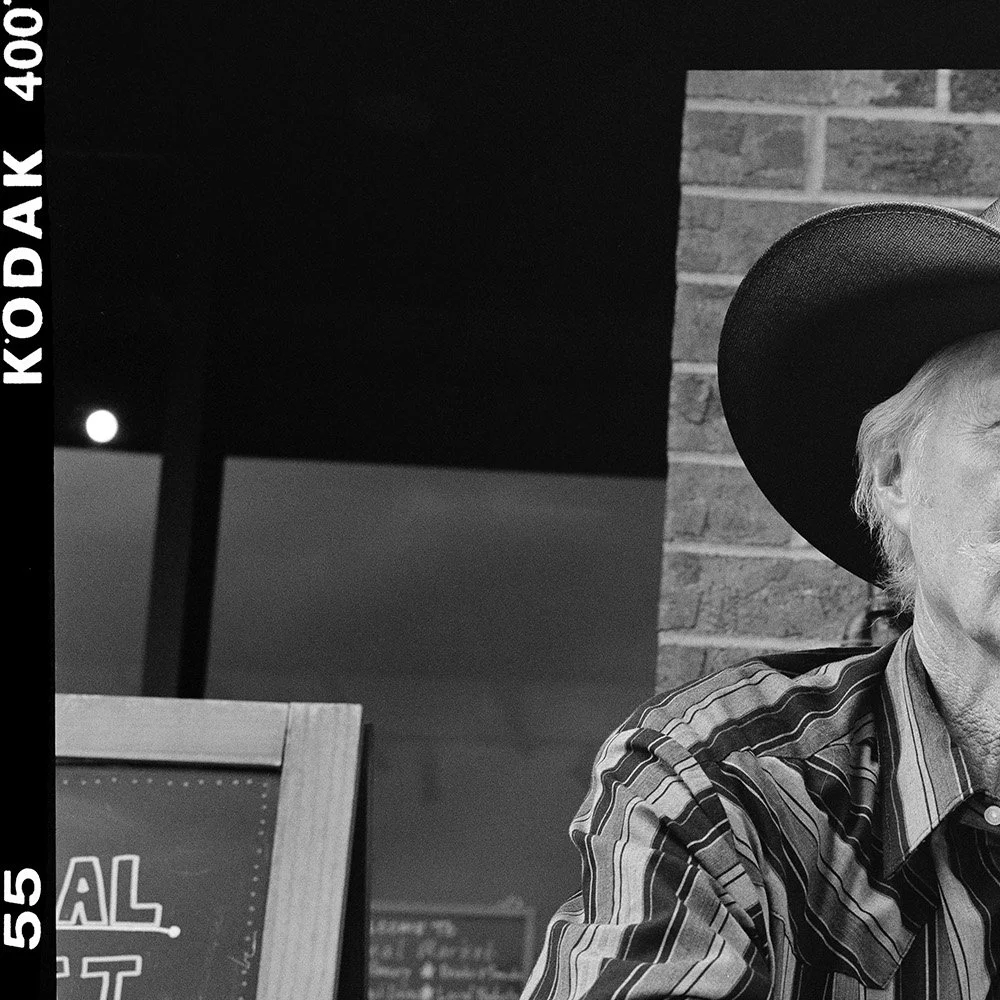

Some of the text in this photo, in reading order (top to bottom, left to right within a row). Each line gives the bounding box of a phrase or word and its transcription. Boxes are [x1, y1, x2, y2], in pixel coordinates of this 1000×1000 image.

[2, 0, 43, 384] KODAK 400
[4, 868, 41, 949] 55
